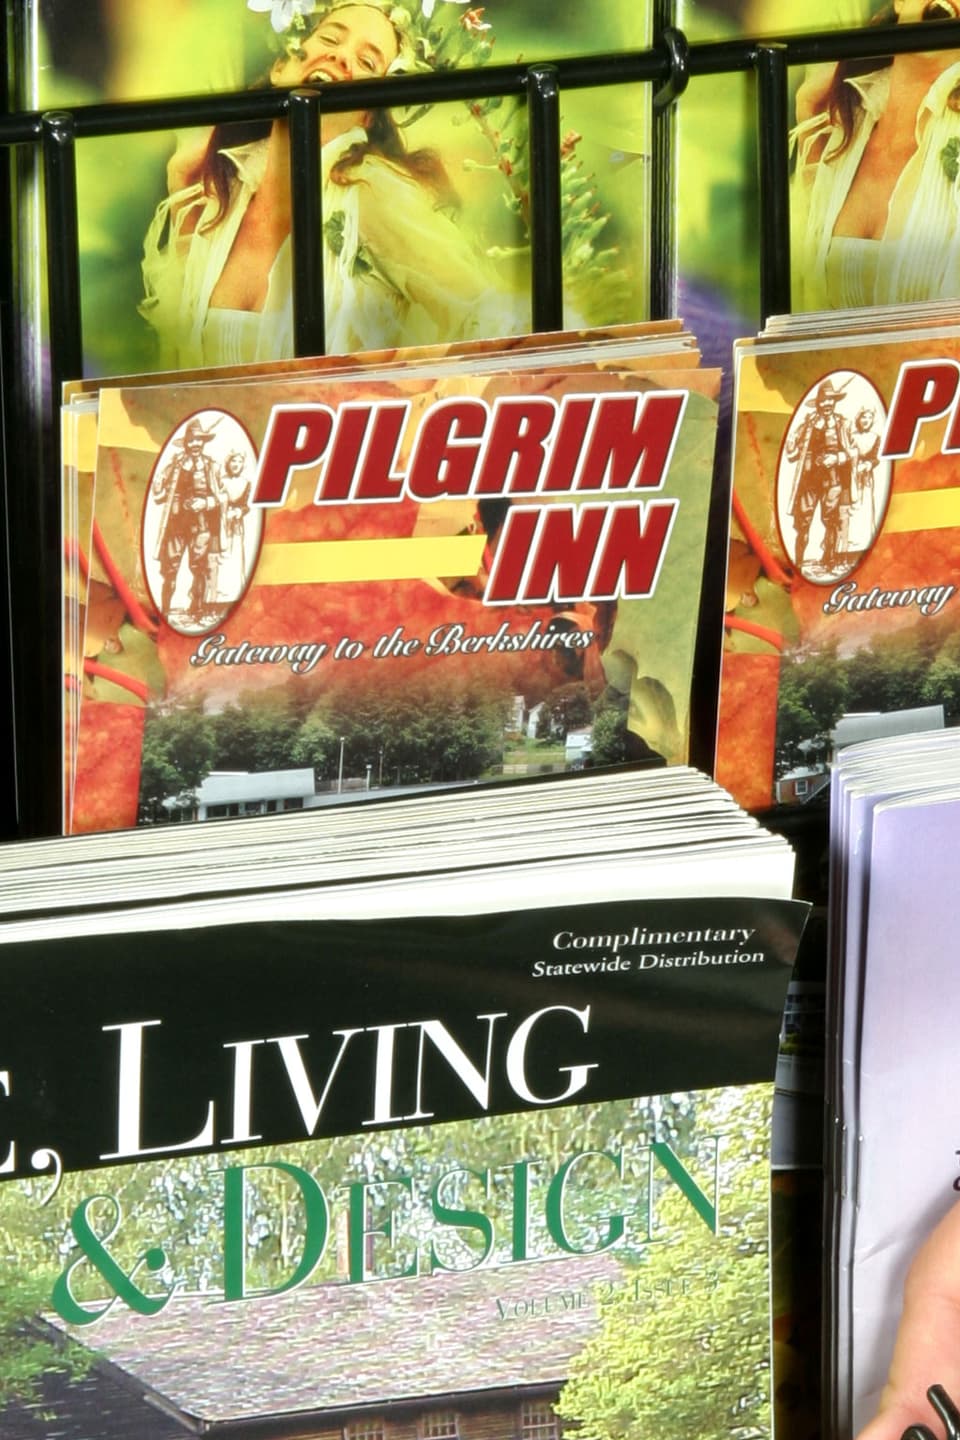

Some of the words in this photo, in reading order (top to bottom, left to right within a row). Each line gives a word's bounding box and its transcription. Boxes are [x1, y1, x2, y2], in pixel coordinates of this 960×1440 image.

[249, 389, 689, 508] PILGRIM
[483, 498, 679, 607] INN
[823, 581, 954, 616] Gateway
[190, 633, 327, 674] Gateway
[333, 636, 363, 662] to
[373, 626, 421, 659] the
[425, 621, 595, 656] Berkshires
[532, 955, 631, 978] Statewide
[637, 951, 765, 971] Distribution
[552, 927, 756, 952] Complimentary
[99, 1004, 599, 1162] LIVING
[50, 1193, 180, 1327] &
[205, 1133, 725, 1305] DESIGN
